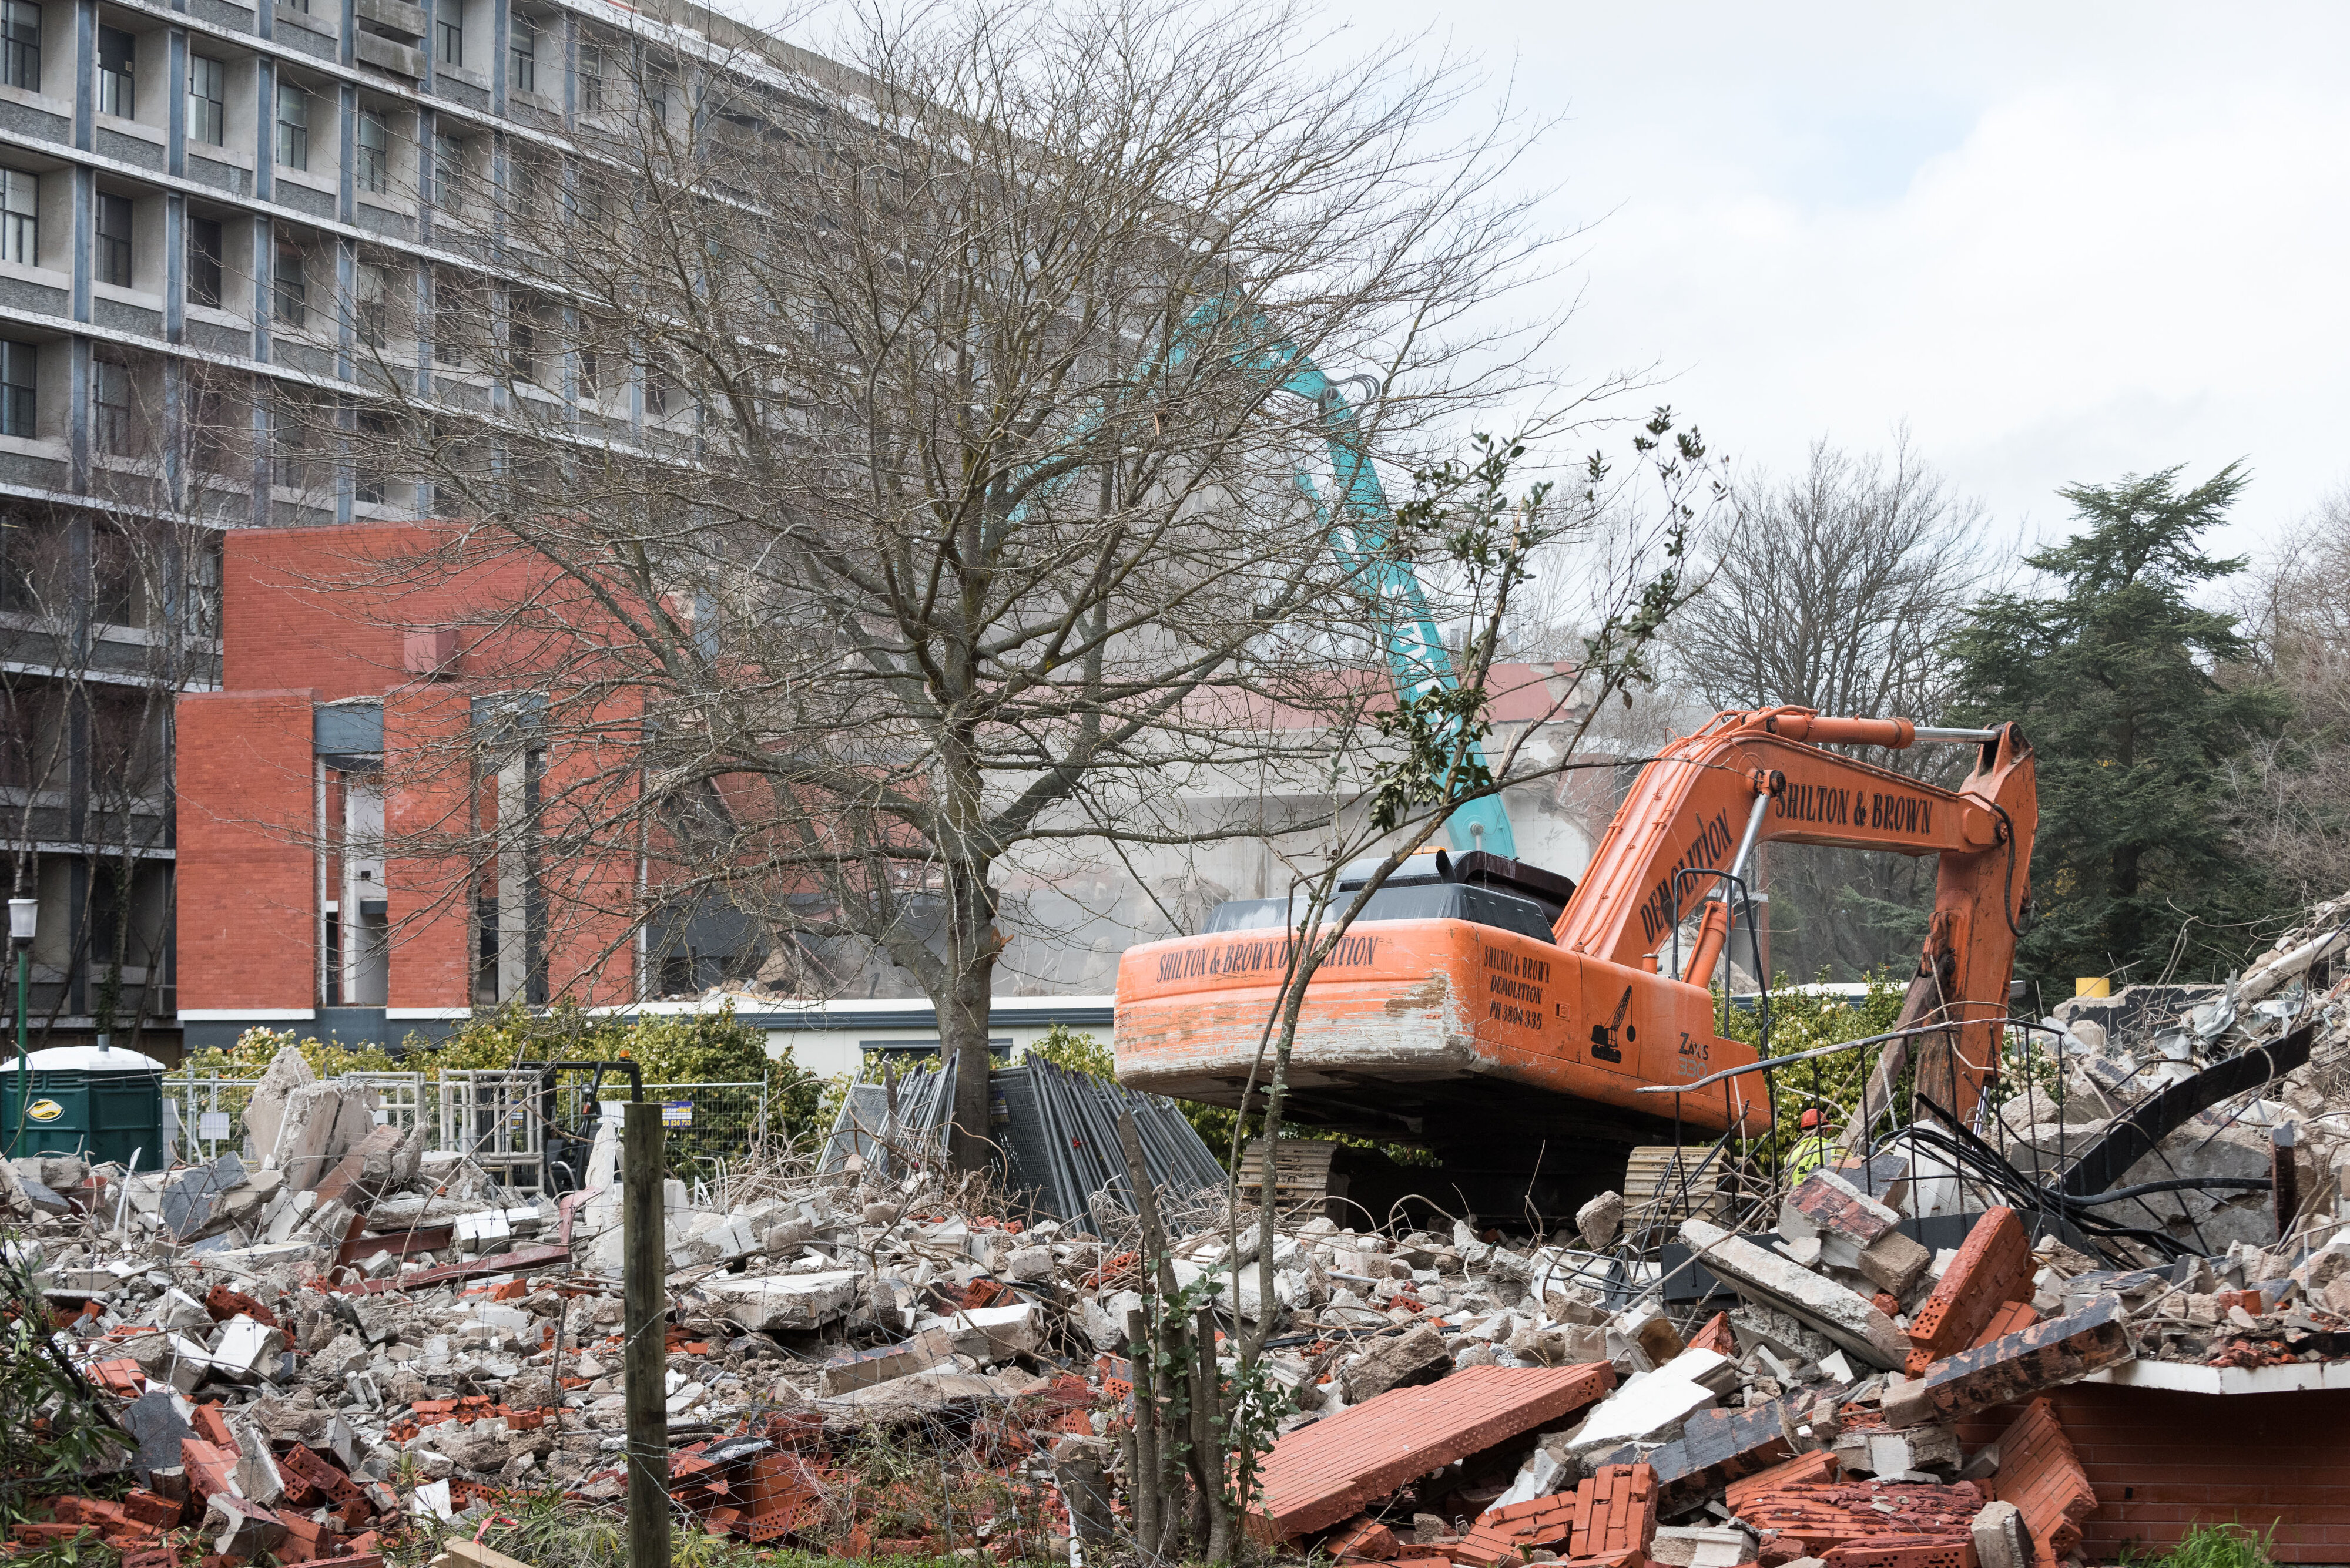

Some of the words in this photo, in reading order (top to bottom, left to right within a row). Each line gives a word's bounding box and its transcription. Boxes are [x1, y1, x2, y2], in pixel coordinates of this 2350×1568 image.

[1775, 782, 1850, 825] SHILTON
[1853, 790, 1866, 827] &
[1872, 793, 1933, 835] BROWN
[1156, 948, 1210, 983] SHILTON
[1209, 945, 1221, 975] &
[1223, 940, 1279, 973] BROWN
[1484, 945, 1513, 975] SHILTON
[1514, 955, 1520, 976] &
[1522, 956, 1551, 984] BROWN
[1490, 974, 1543, 1005] DEMOLITION
[1489, 1000, 1502, 1020] PH
[1524, 1009, 1543, 1030] 335
[1678, 1056, 1708, 1080] 330
